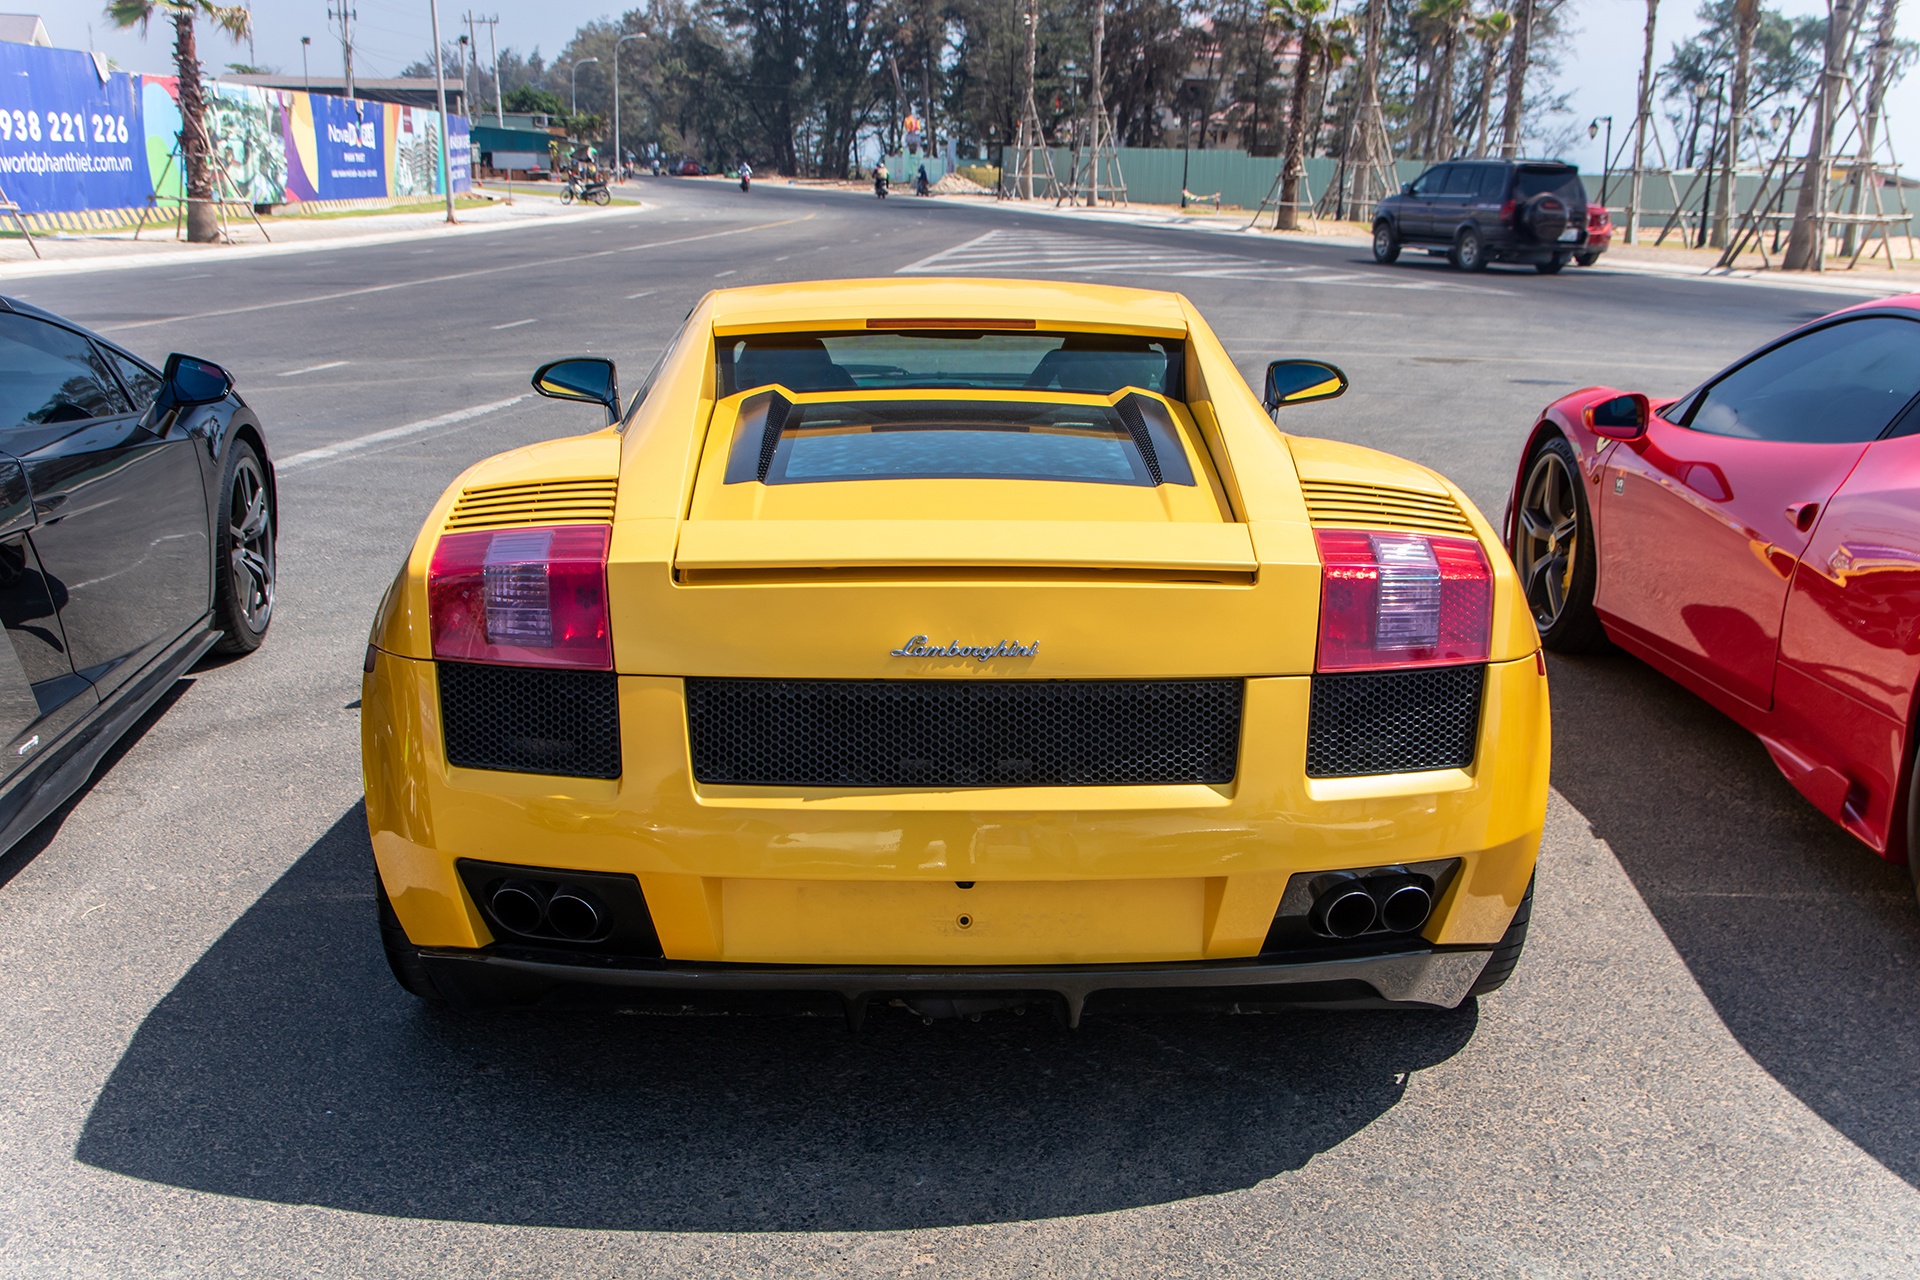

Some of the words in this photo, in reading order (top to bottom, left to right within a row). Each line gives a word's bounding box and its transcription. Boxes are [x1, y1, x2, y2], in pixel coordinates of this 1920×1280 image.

[0, 109, 42, 142] 938
[47, 111, 85, 142] 221
[91, 114, 129, 144] 226
[0, 151, 133, 177] worldphanthiet.com.vn
[890, 634, 1040, 662] Lamborghini
